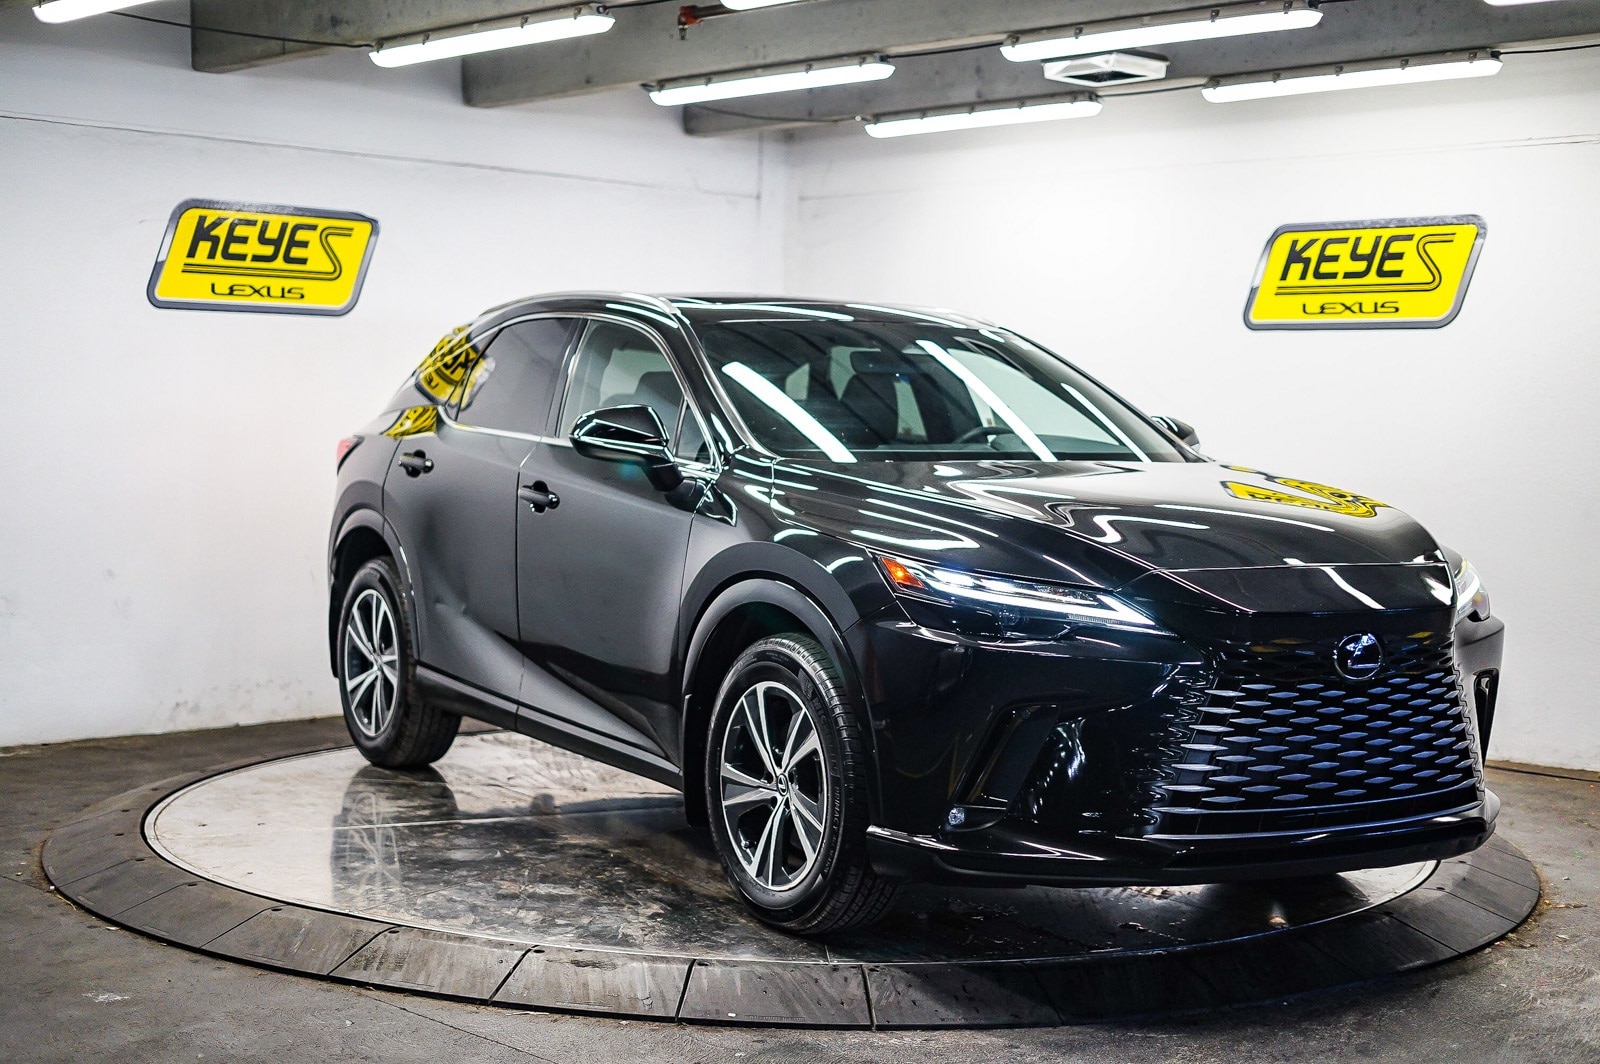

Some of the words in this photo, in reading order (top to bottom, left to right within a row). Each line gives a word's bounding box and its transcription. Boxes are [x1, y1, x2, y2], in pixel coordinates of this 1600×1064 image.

[185, 214, 354, 281] KEYES
[1279, 232, 1456, 292] KEYES
[210, 282, 305, 300] LEXUS
[1302, 300, 1400, 315] LEXUS
